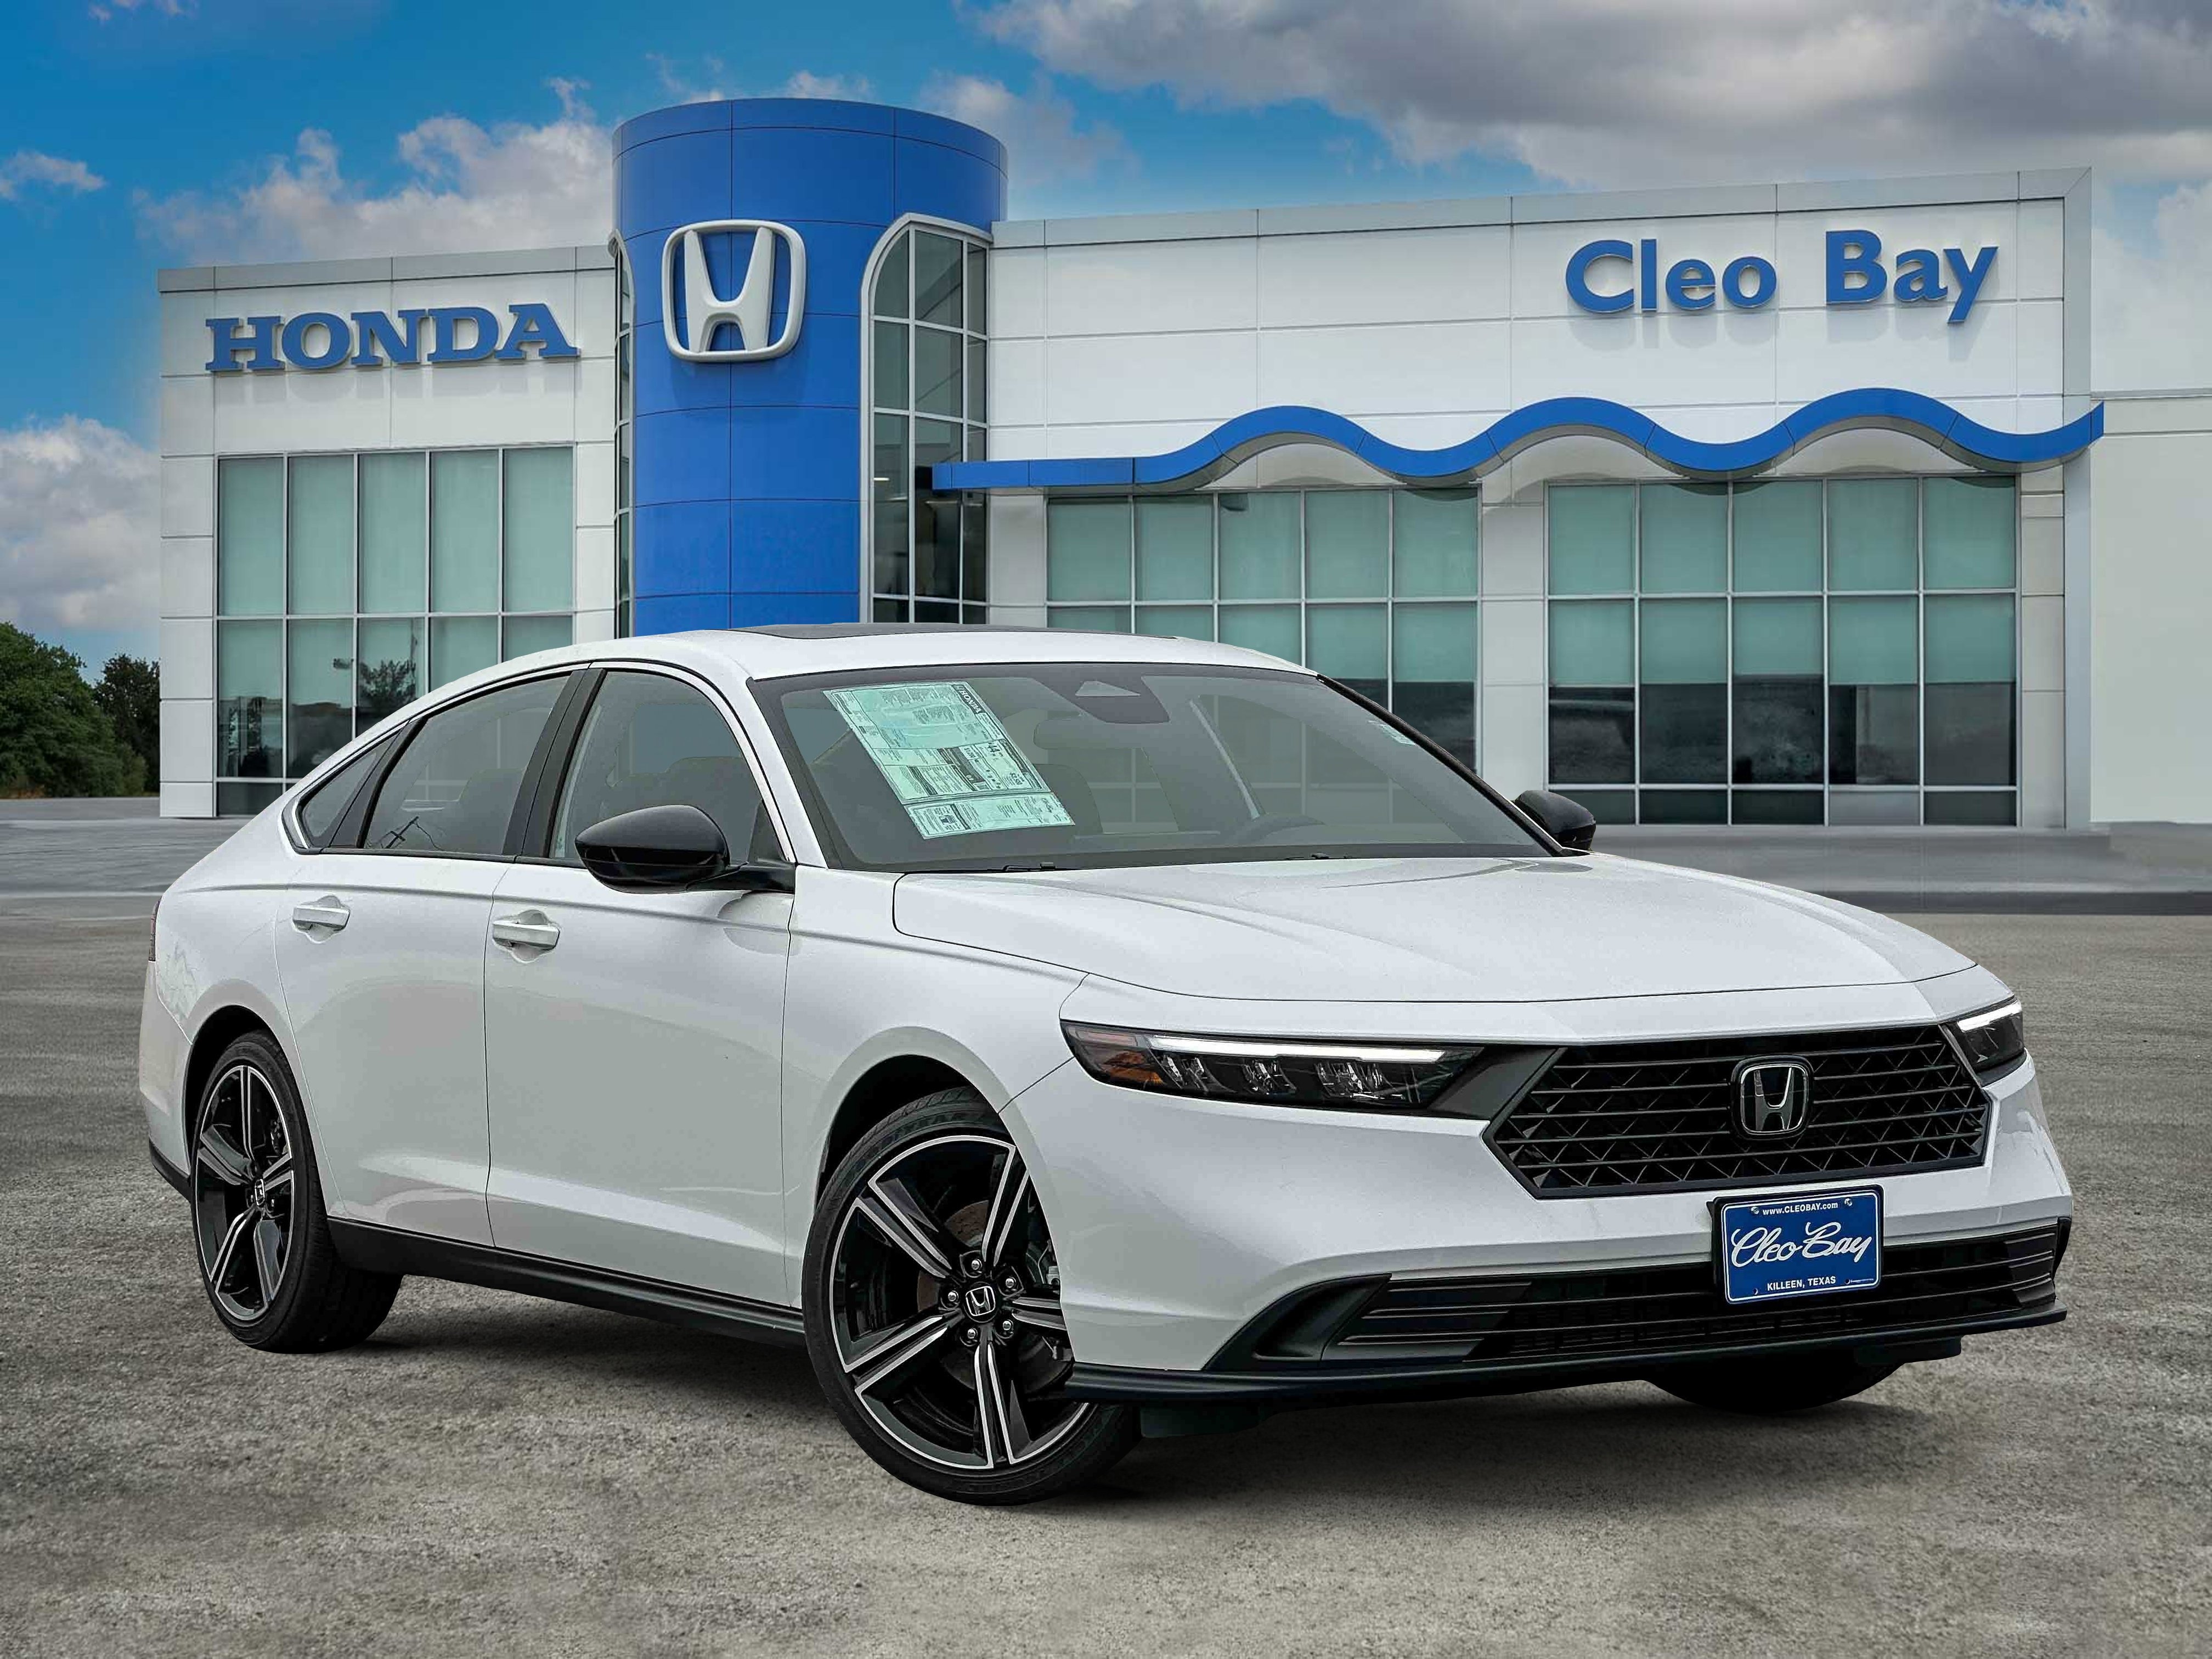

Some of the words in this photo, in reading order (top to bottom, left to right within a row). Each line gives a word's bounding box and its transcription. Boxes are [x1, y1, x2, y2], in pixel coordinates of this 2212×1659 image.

[1566, 238, 1777, 314] Cleo
[1825, 229, 1999, 324] Bay
[205, 303, 580, 373] HONDA
[959, 690, 982, 714] HONDA
[1762, 1202, 1838, 1216] www.CLEOBAY.com
[1730, 1227, 1803, 1268] Cleo
[1802, 1222, 1872, 1263] Bay
[1767, 1279, 1805, 1291] KILLEEN,
[1808, 1276, 1837, 1287] TEXAS
